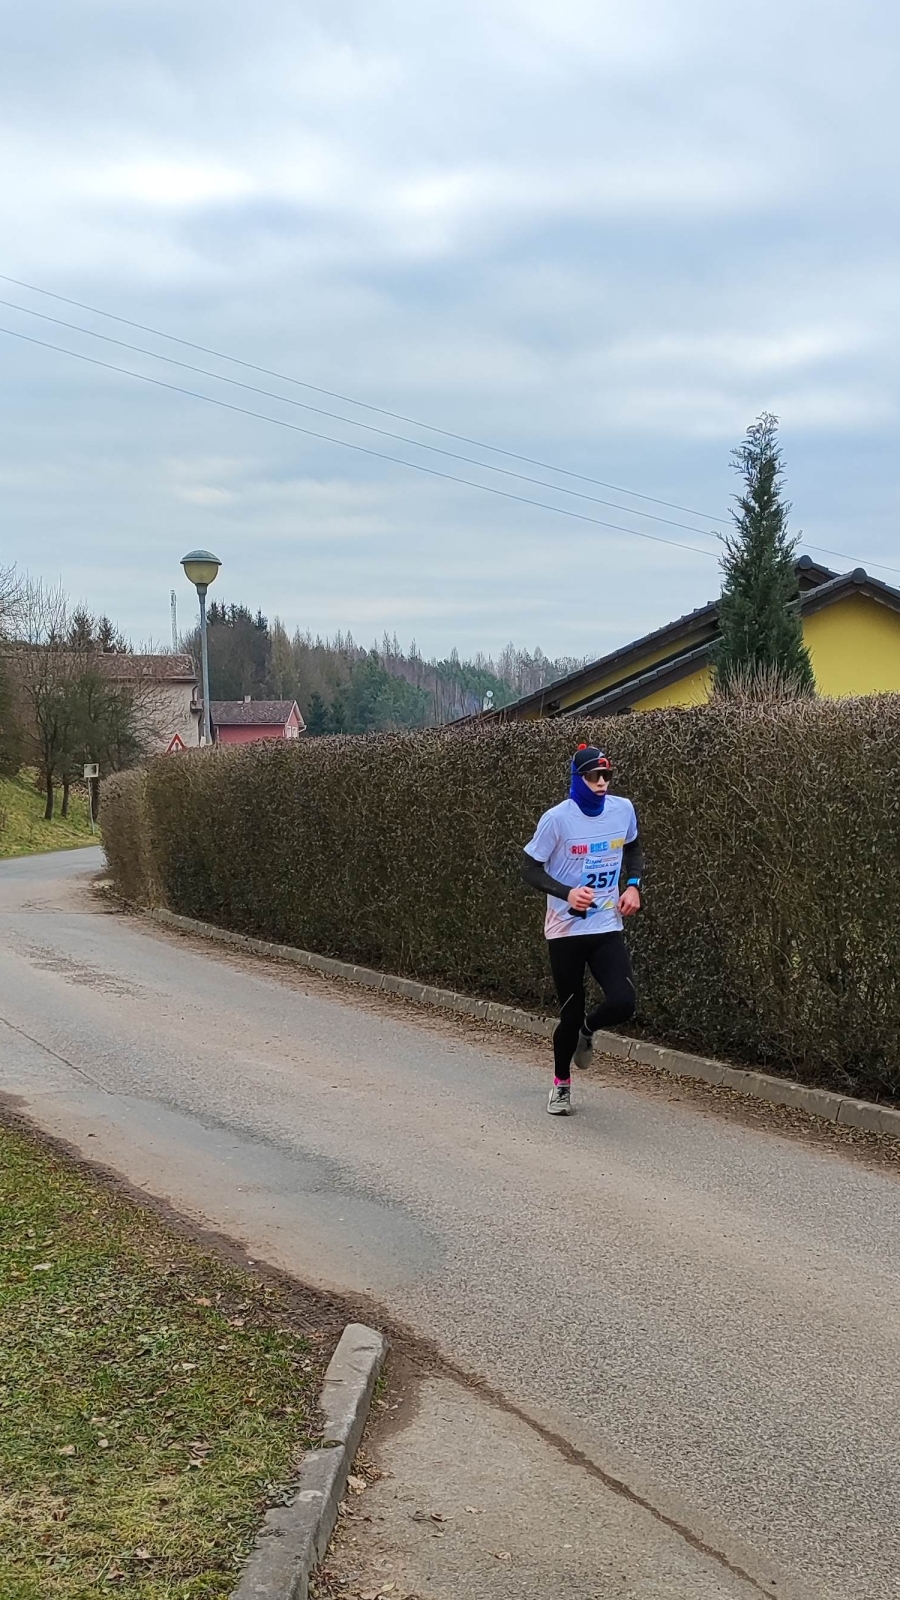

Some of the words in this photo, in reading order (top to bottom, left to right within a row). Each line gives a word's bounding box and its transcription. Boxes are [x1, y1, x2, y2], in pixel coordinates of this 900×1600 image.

[572, 845, 588, 855] RUN
[590, 841, 608, 853] BIKE
[585, 870, 617, 889] 257
